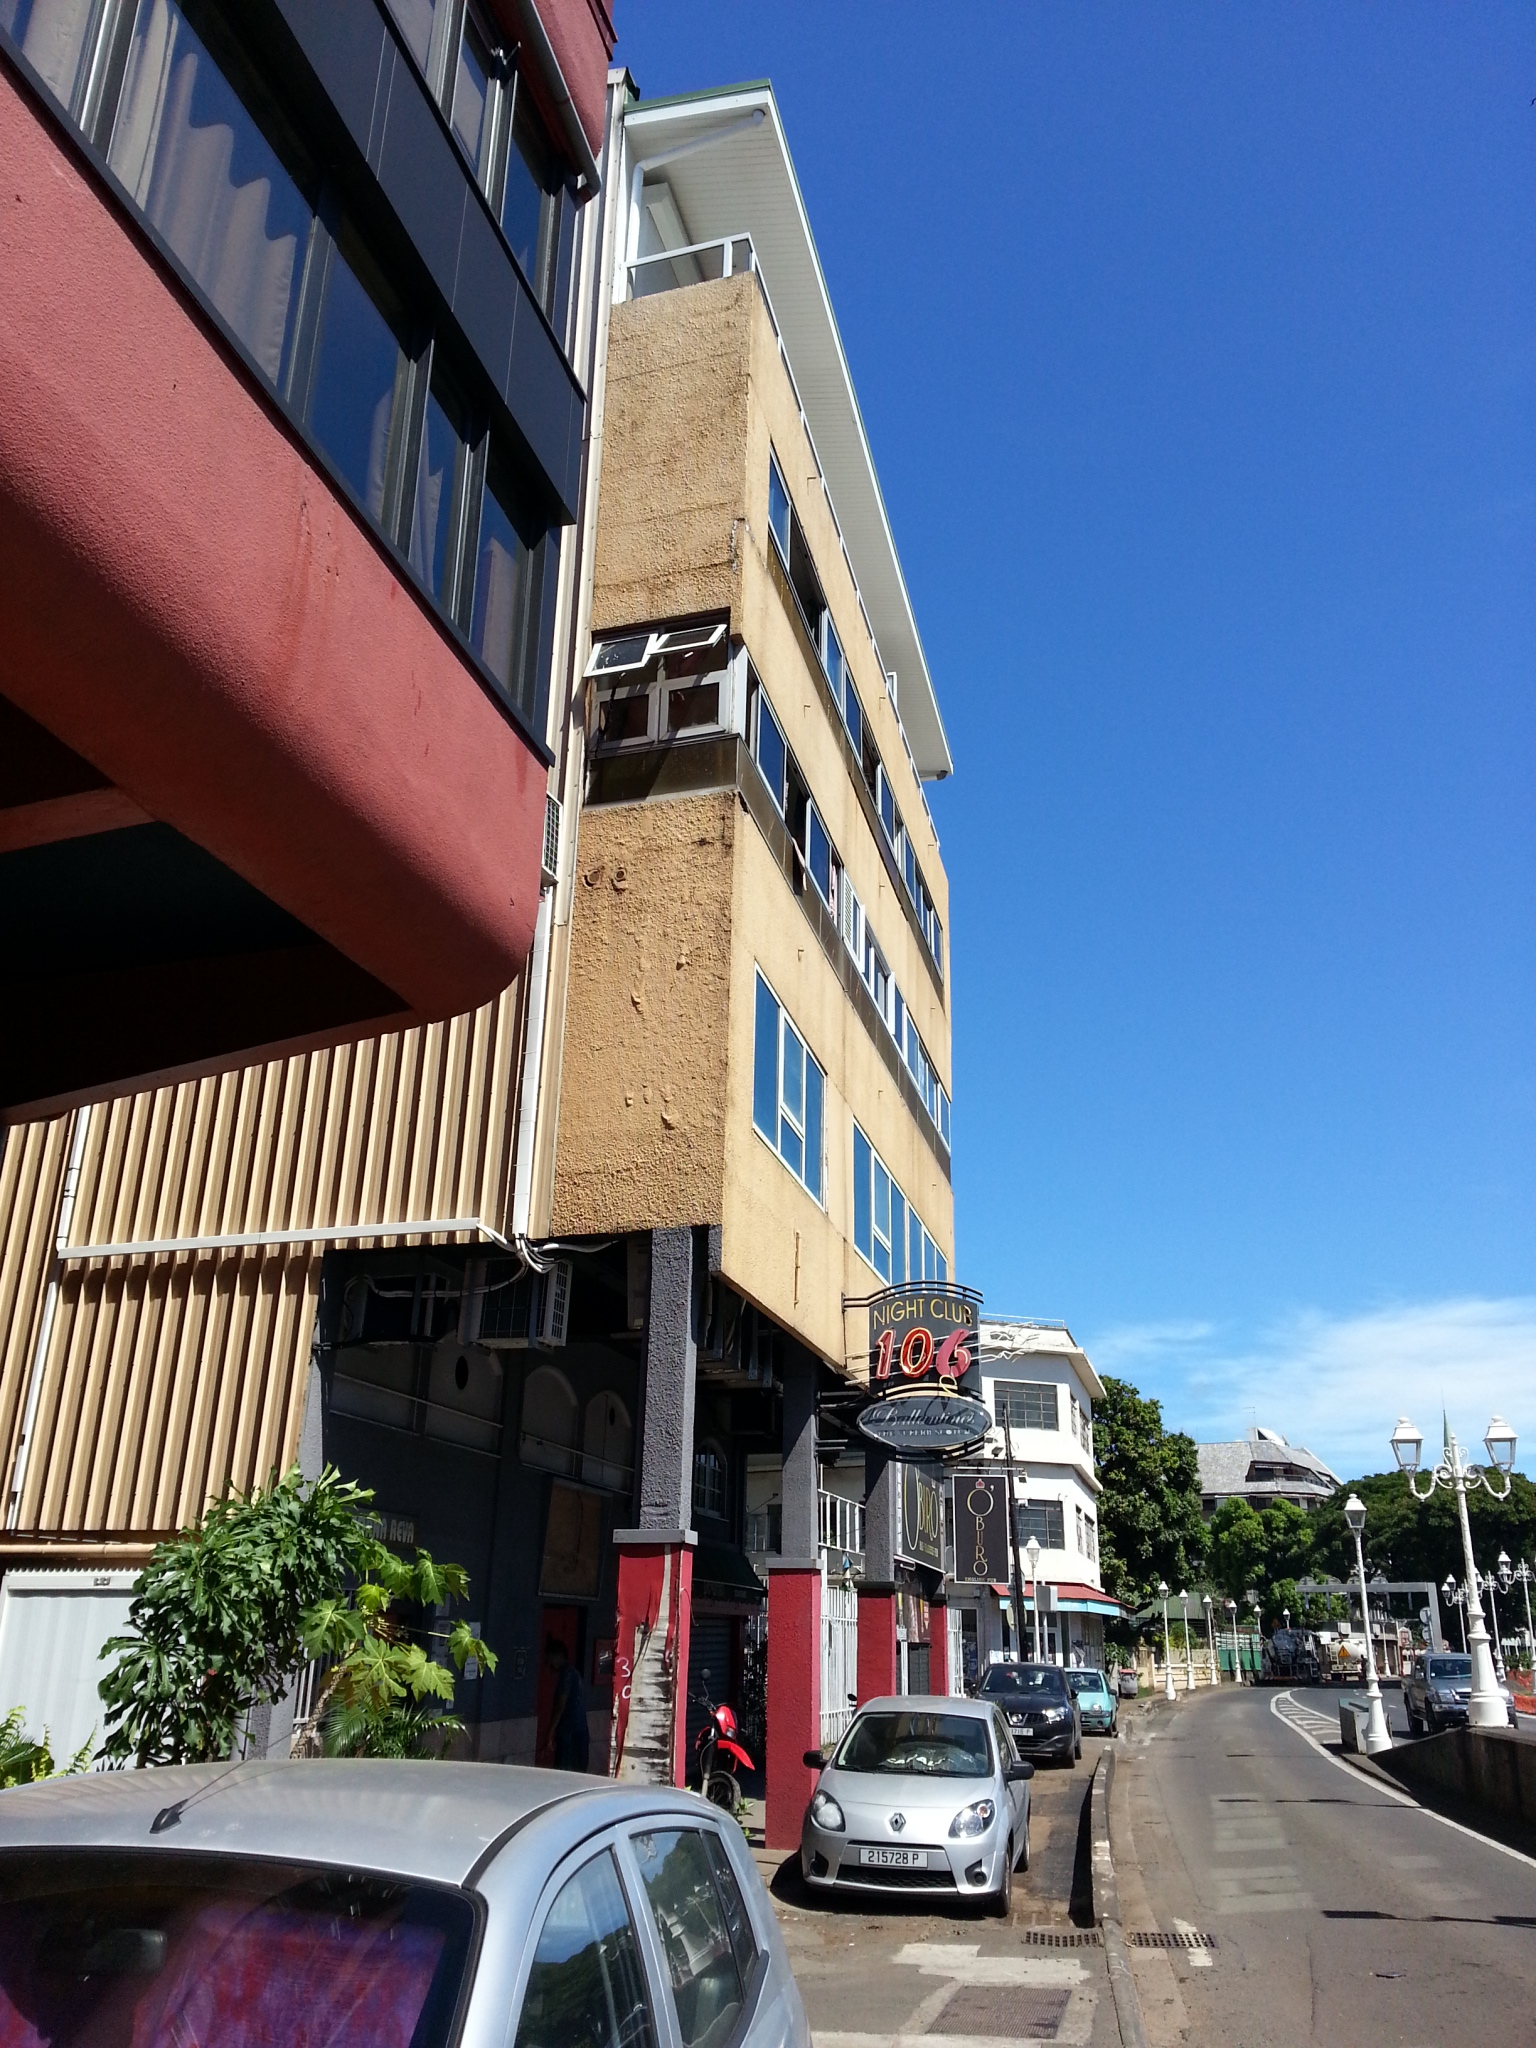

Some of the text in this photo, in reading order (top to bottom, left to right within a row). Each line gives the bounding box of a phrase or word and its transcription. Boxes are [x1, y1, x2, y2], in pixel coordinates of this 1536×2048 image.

[873, 1298, 973, 1331] NIGHT CLUB
[875, 1326, 972, 1380] 106
[867, 1850, 919, 1866] 215728 P
